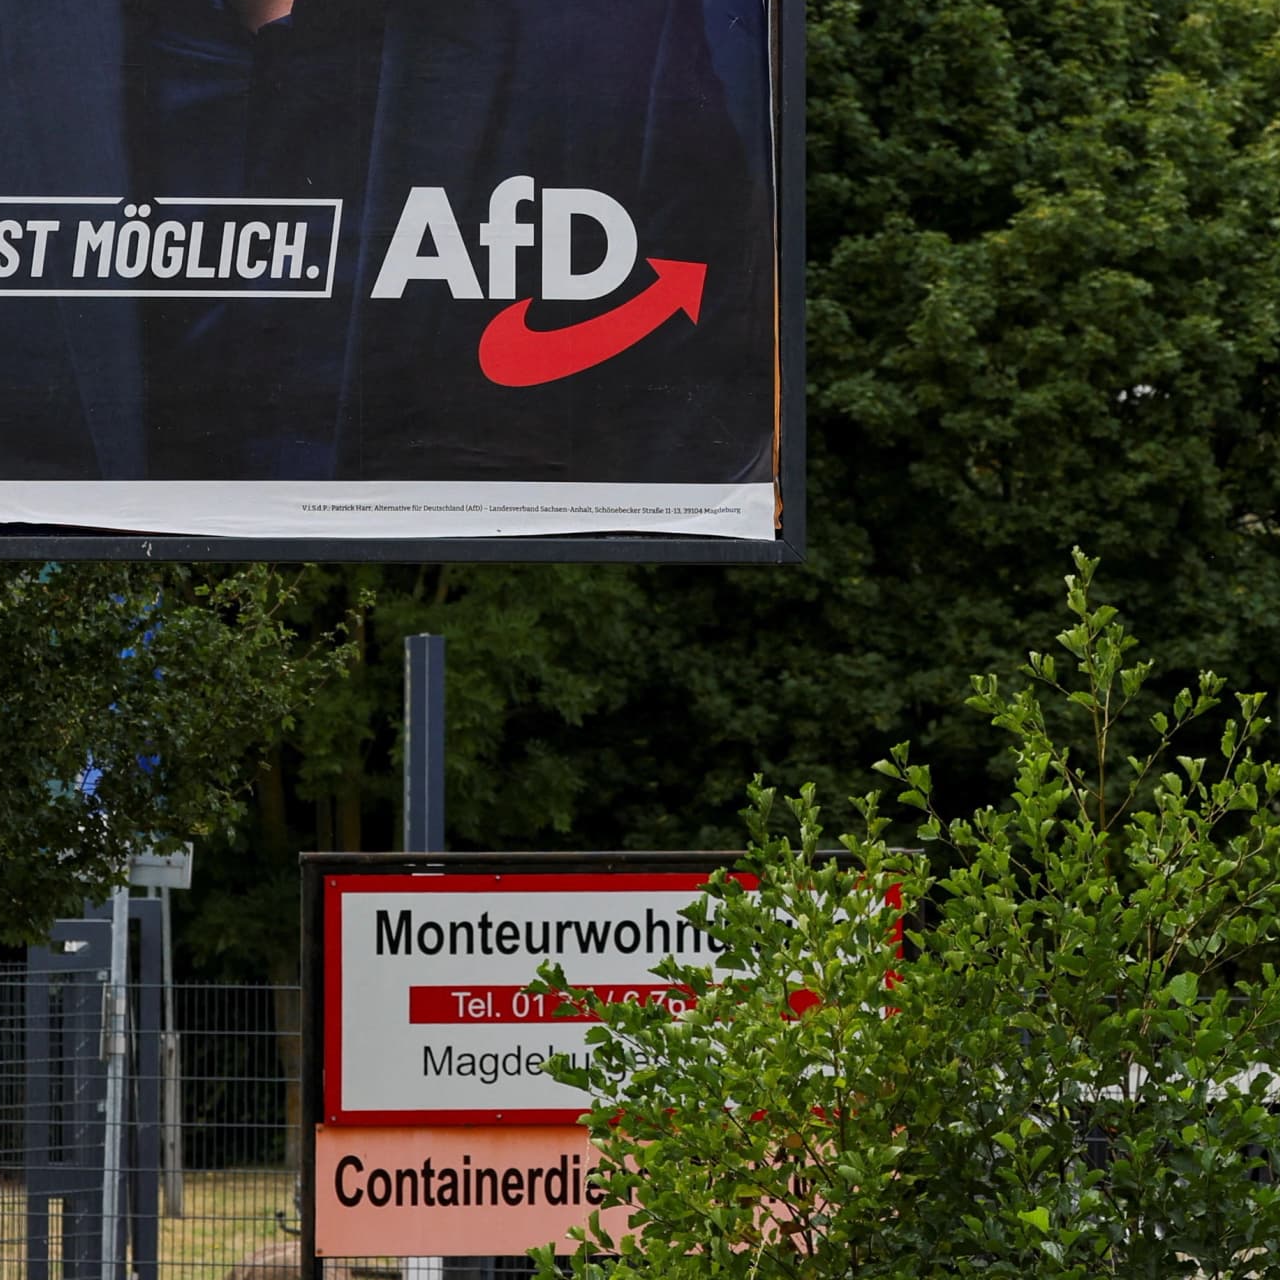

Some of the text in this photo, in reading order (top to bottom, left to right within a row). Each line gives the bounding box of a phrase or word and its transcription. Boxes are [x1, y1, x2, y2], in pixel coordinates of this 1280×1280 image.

[72, 204, 321, 279] MÖGLICH.
[370, 175, 638, 301] AfD
[331, 503, 354, 512] Patrick
[374, 504, 410, 512] Alternative
[411, 504, 421, 512] für
[423, 504, 464, 512] Deutschland
[465, 503, 482, 513] (AfD)
[489, 504, 538, 513] Landesverband
[540, 505, 594, 514] Sachsen-Anhalt,
[595, 506, 640, 514] Schönebecker
[642, 506, 663, 514] Straße
[684, 506, 702, 514] 39104
[703, 506, 741, 514] Magdeburg
[451, 991, 502, 1018] Tel.
